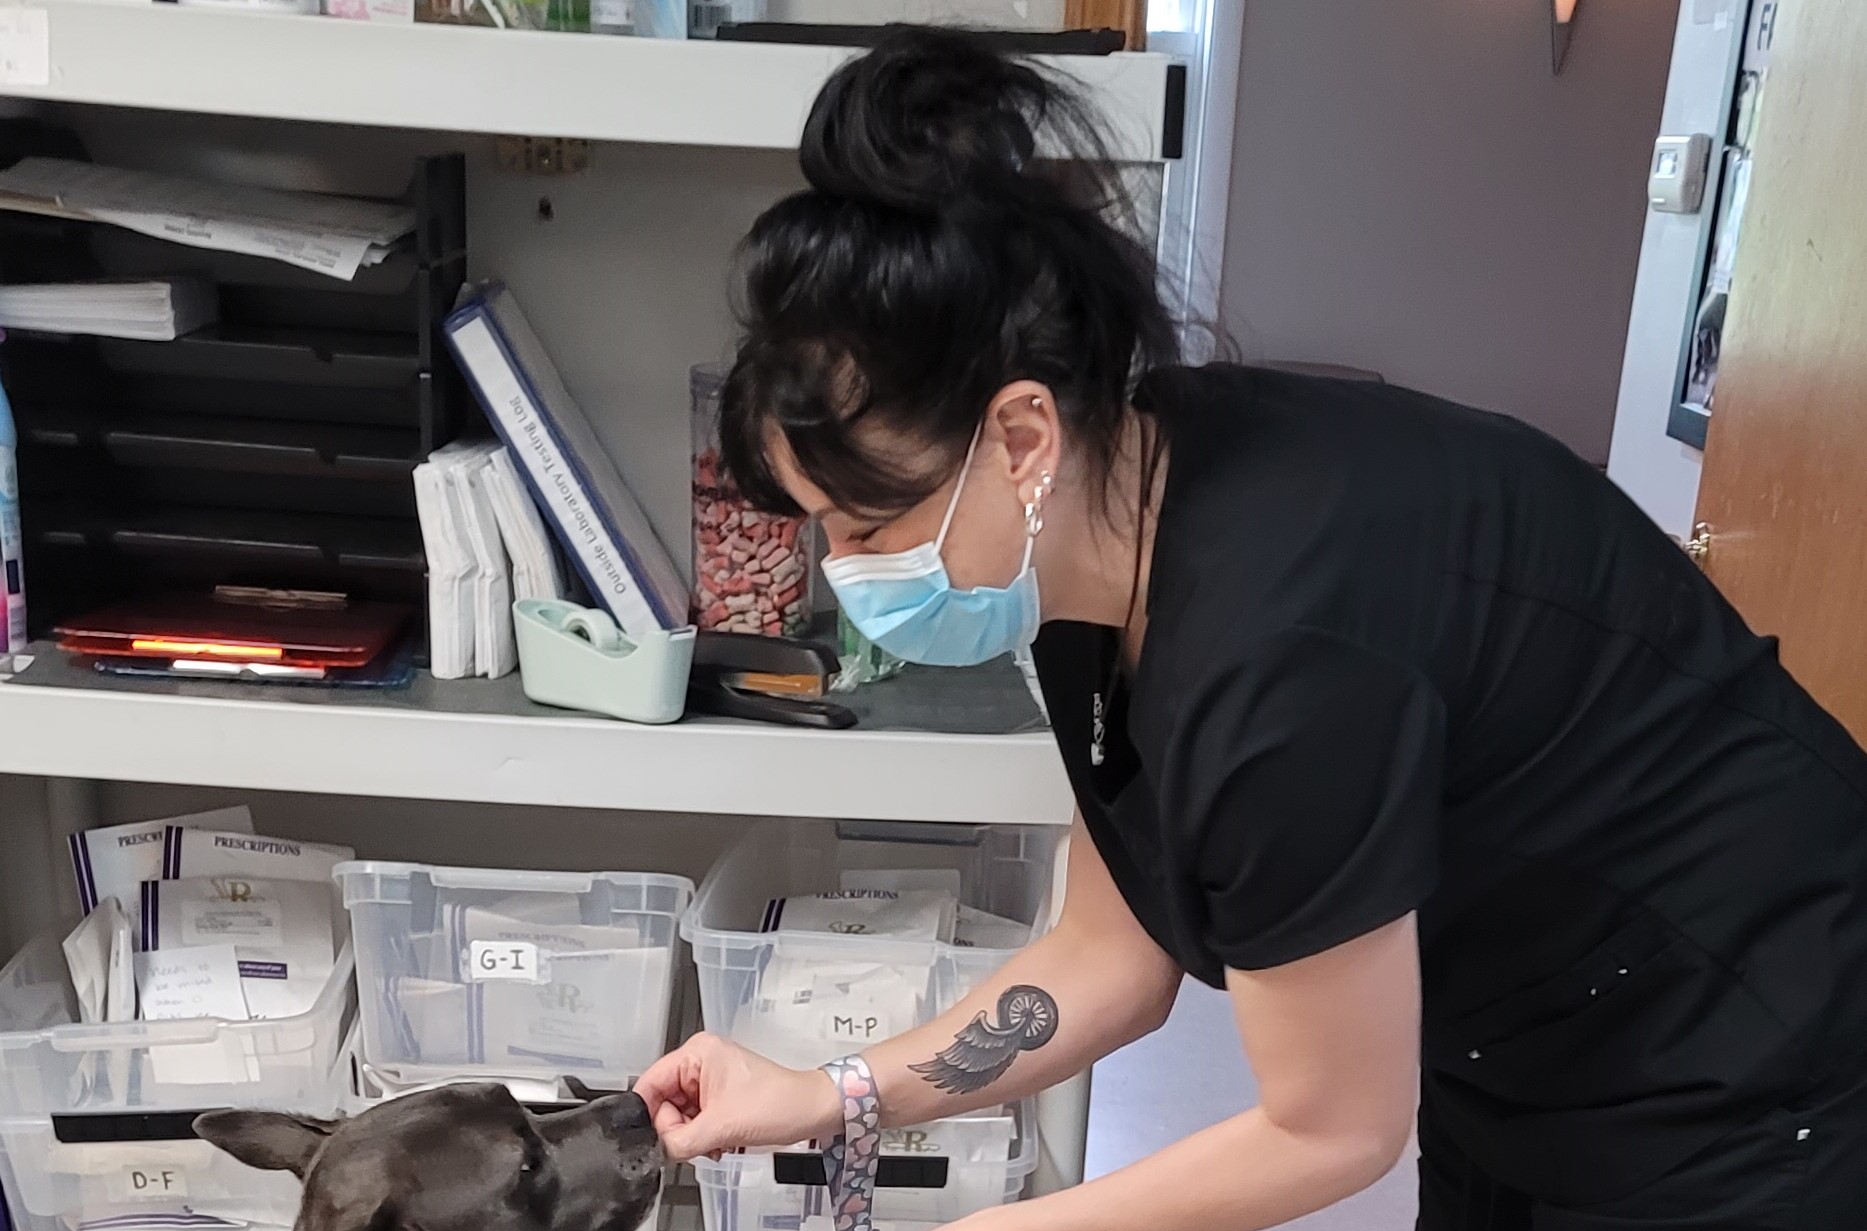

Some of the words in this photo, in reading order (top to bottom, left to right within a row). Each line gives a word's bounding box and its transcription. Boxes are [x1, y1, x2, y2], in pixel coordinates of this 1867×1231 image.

[509, 395, 529, 424] Log
[524, 422, 556, 474] Testing
[552, 470, 598, 544] Laboratory
[593, 545, 627, 595] Outside
[214, 836, 301, 856] PRESCRIPTIONS
[815, 889, 899, 900] PRESCRIPTIONS
[480, 949, 526, 970] G-I
[833, 1015, 878, 1037] M-P
[132, 1171, 175, 1190] D-F
